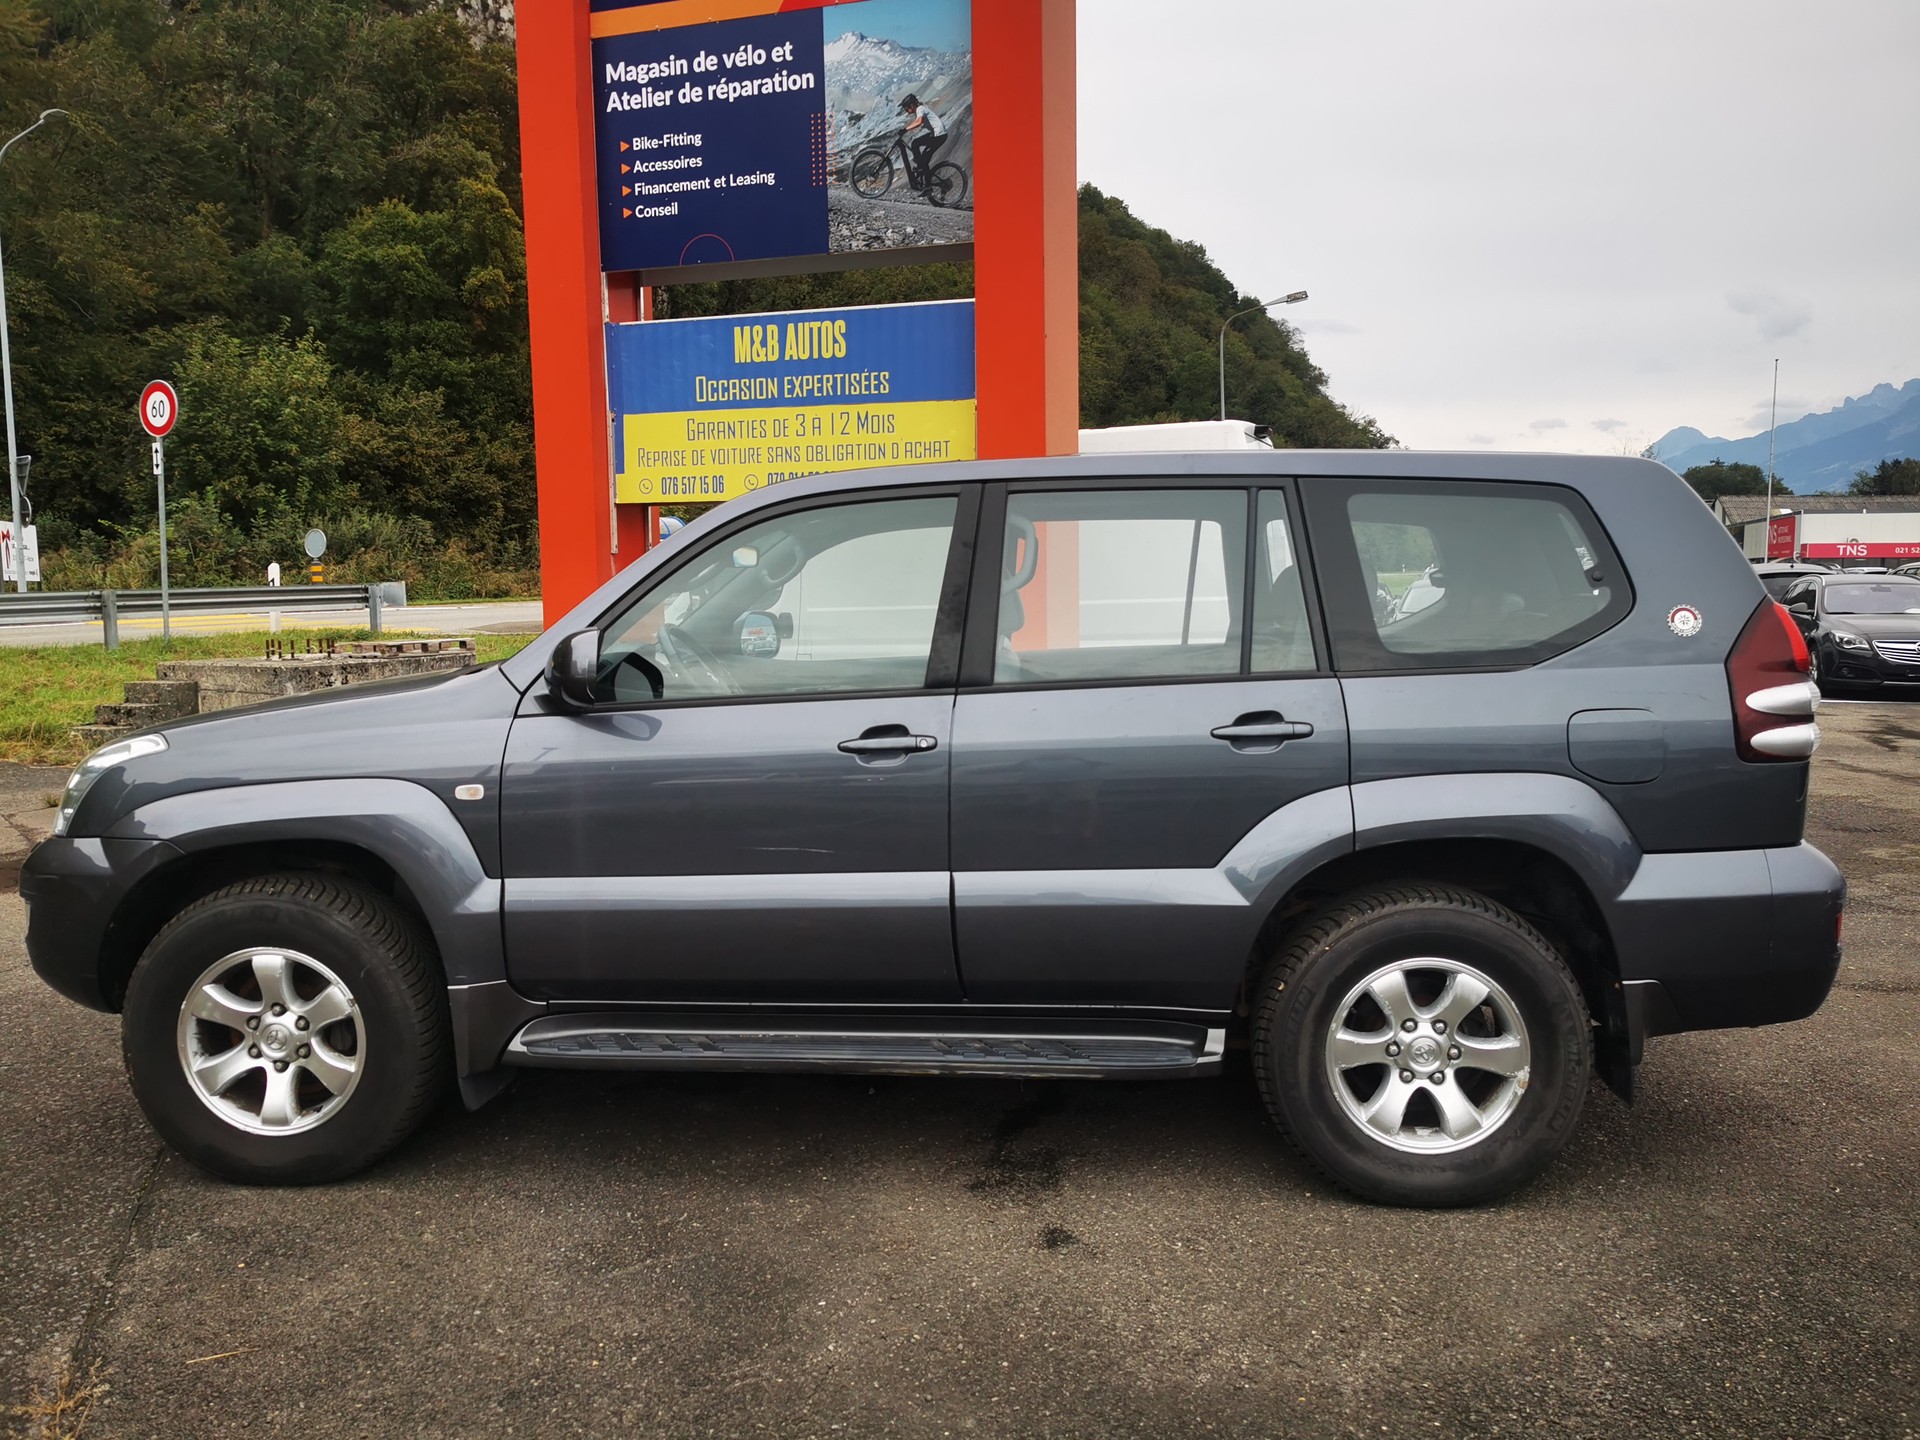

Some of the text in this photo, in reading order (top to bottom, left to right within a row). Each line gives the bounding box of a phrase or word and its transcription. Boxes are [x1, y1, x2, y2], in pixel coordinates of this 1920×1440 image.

[605, 41, 794, 84] Magasin de vélo et
[606, 70, 815, 113] Atelier de réparation
[632, 132, 702, 151] Bike-Fitting
[633, 155, 703, 173] Accessoires
[634, 171, 775, 196] Financement et Leasing
[635, 202, 678, 218] Conseil
[733, 319, 847, 363] M&B AUTOS
[695, 368, 890, 403] OCCASION EXPERTISÉES
[151, 399, 165, 418] 60
[686, 418, 767, 441] GARANTIES
[772, 418, 790, 438] DE
[795, 413, 806, 437] 3
[857, 410, 895, 434] MOIS
[638, 447, 687, 468] REPRISE
[692, 449, 706, 466] DE
[710, 447, 762, 466] VOITURE
[767, 445, 801, 463] SANS
[806, 443, 886, 462] OBLIGATION
[661, 476, 679, 495] 076
[681, 475, 696, 495] 517
[699, 475, 710, 494] 15
[712, 474, 725, 494] 06
[1836, 544, 1868, 556] TNS
[1894, 546, 1909, 554] 021
